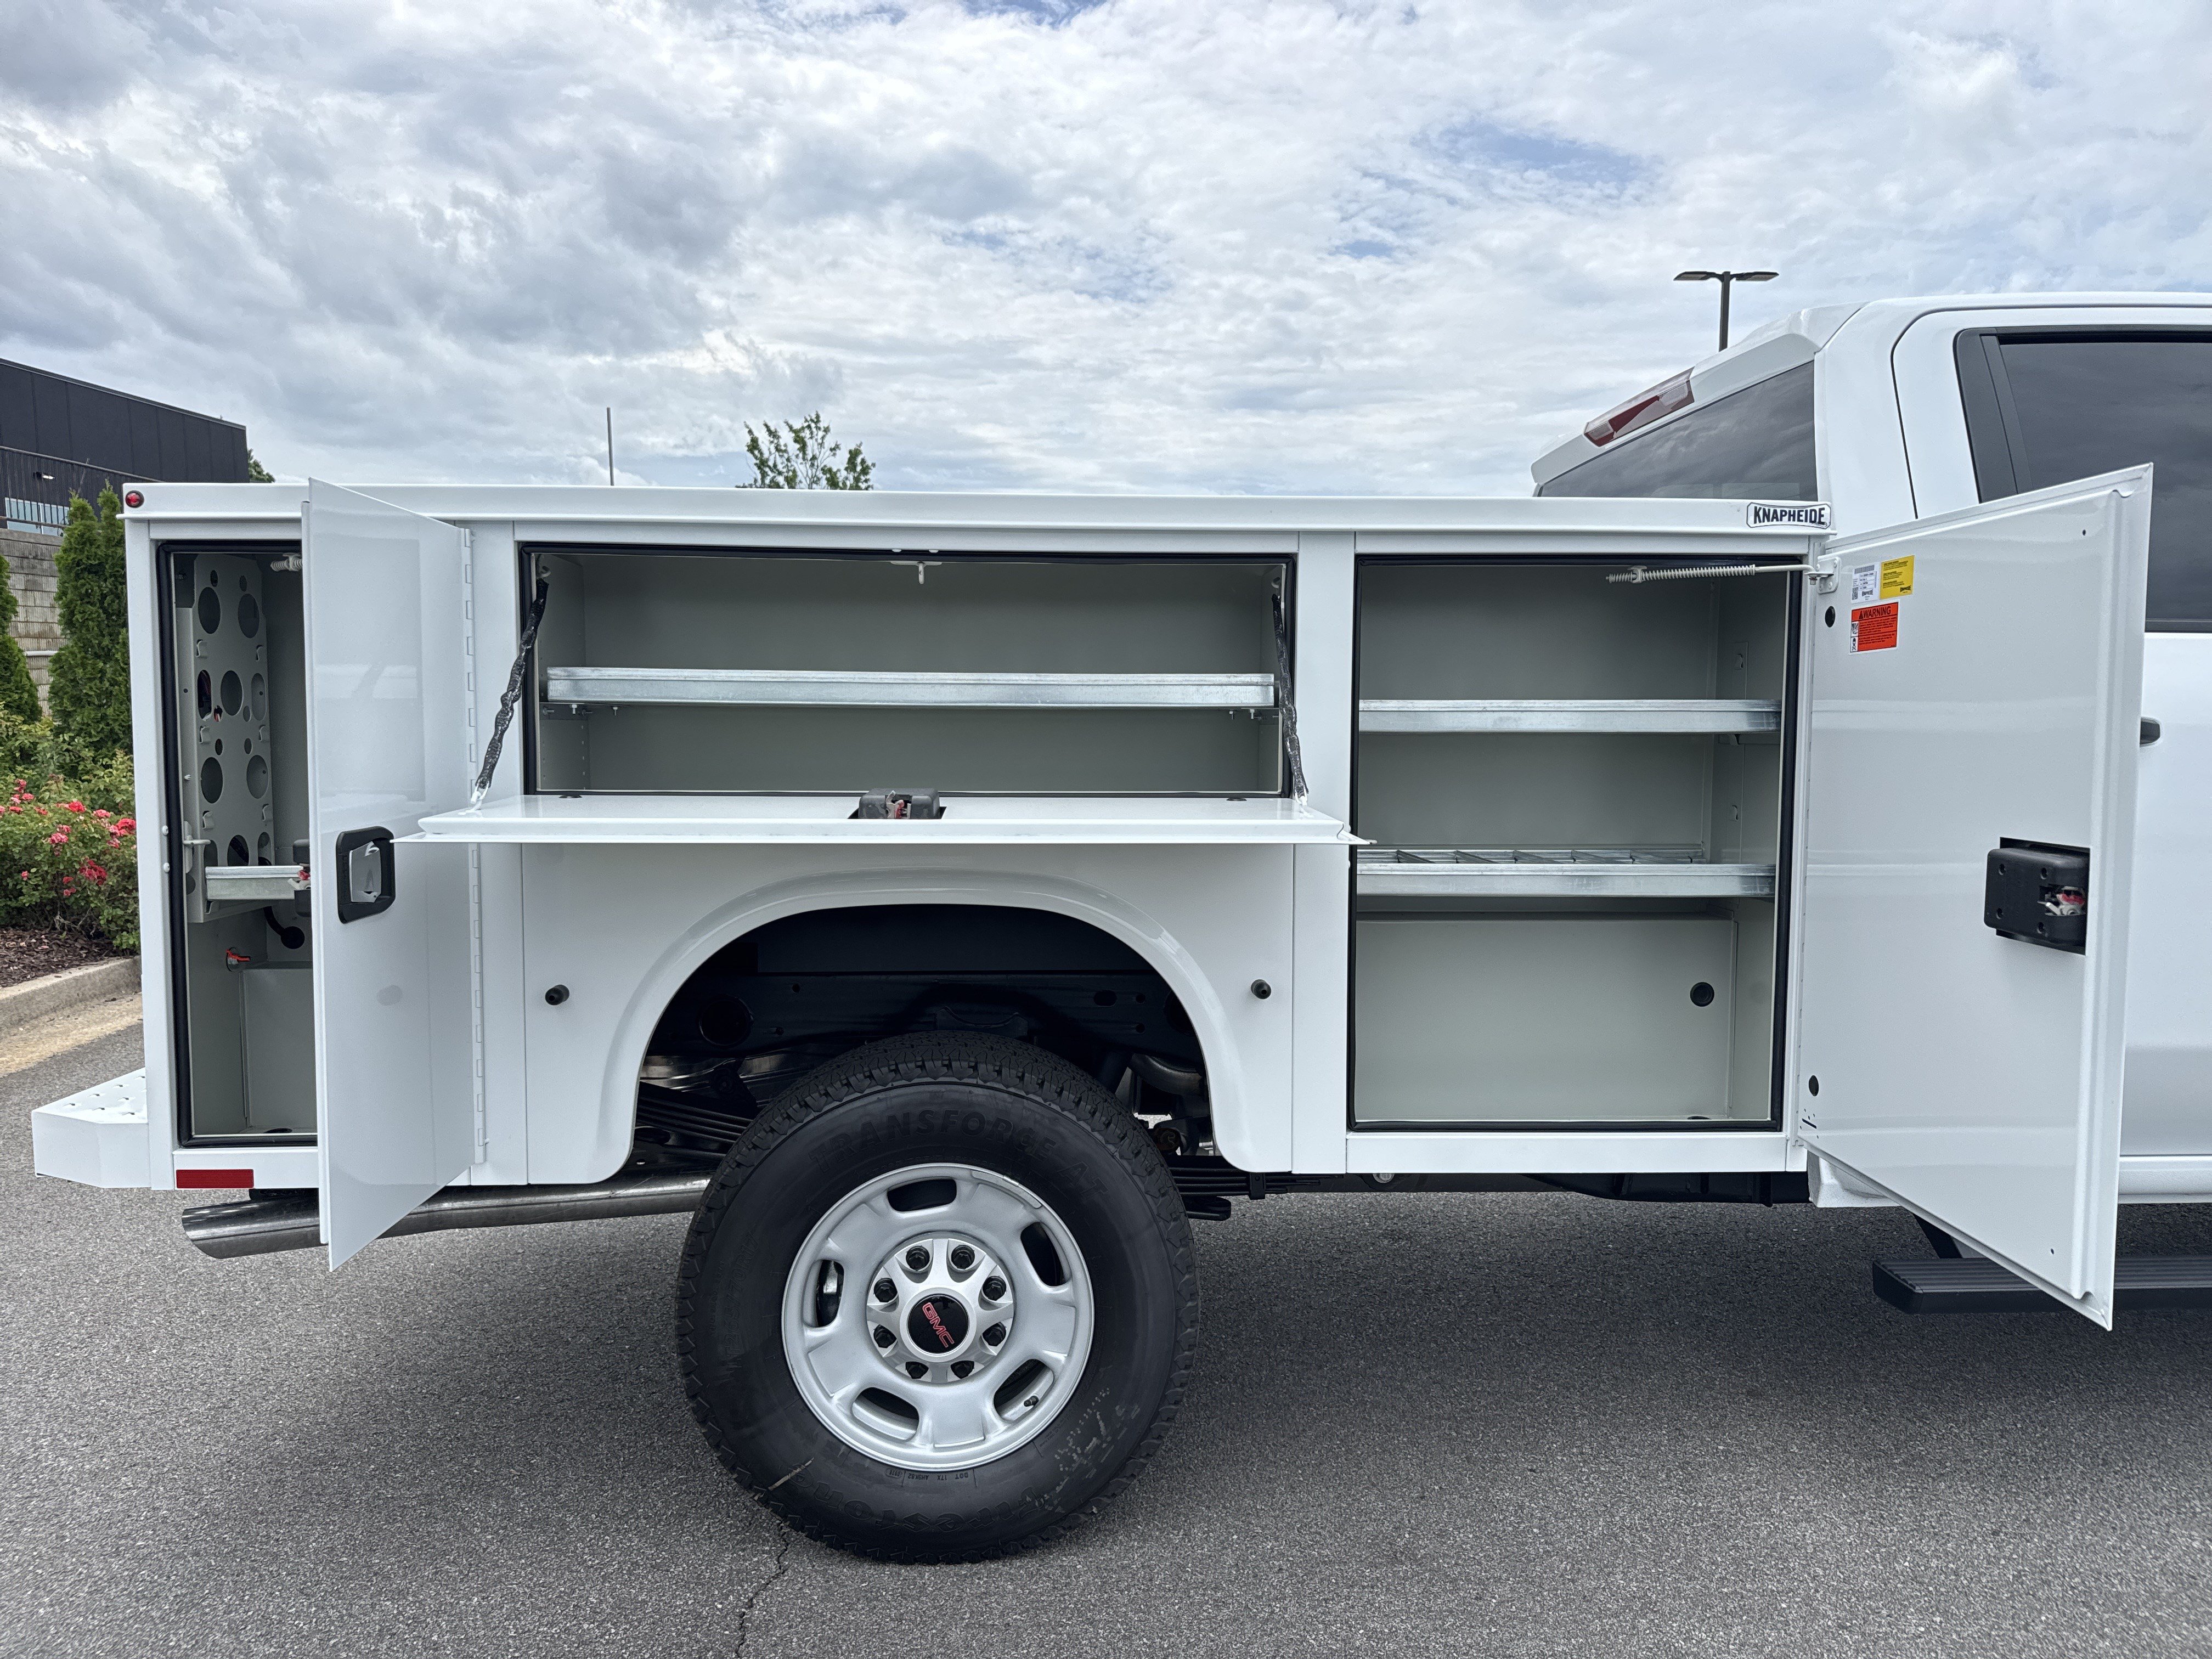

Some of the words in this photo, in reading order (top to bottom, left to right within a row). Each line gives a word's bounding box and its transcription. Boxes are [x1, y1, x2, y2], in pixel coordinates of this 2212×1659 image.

[1754, 506, 1826, 525] KNAPHEIDE
[1863, 606, 1891, 618] WARNING
[808, 1109, 1058, 1174] TRANSFORCE
[1056, 1161, 1110, 1198] AT
[922, 1302, 955, 1348] GMC
[787, 1463, 1045, 1533] Firestone
